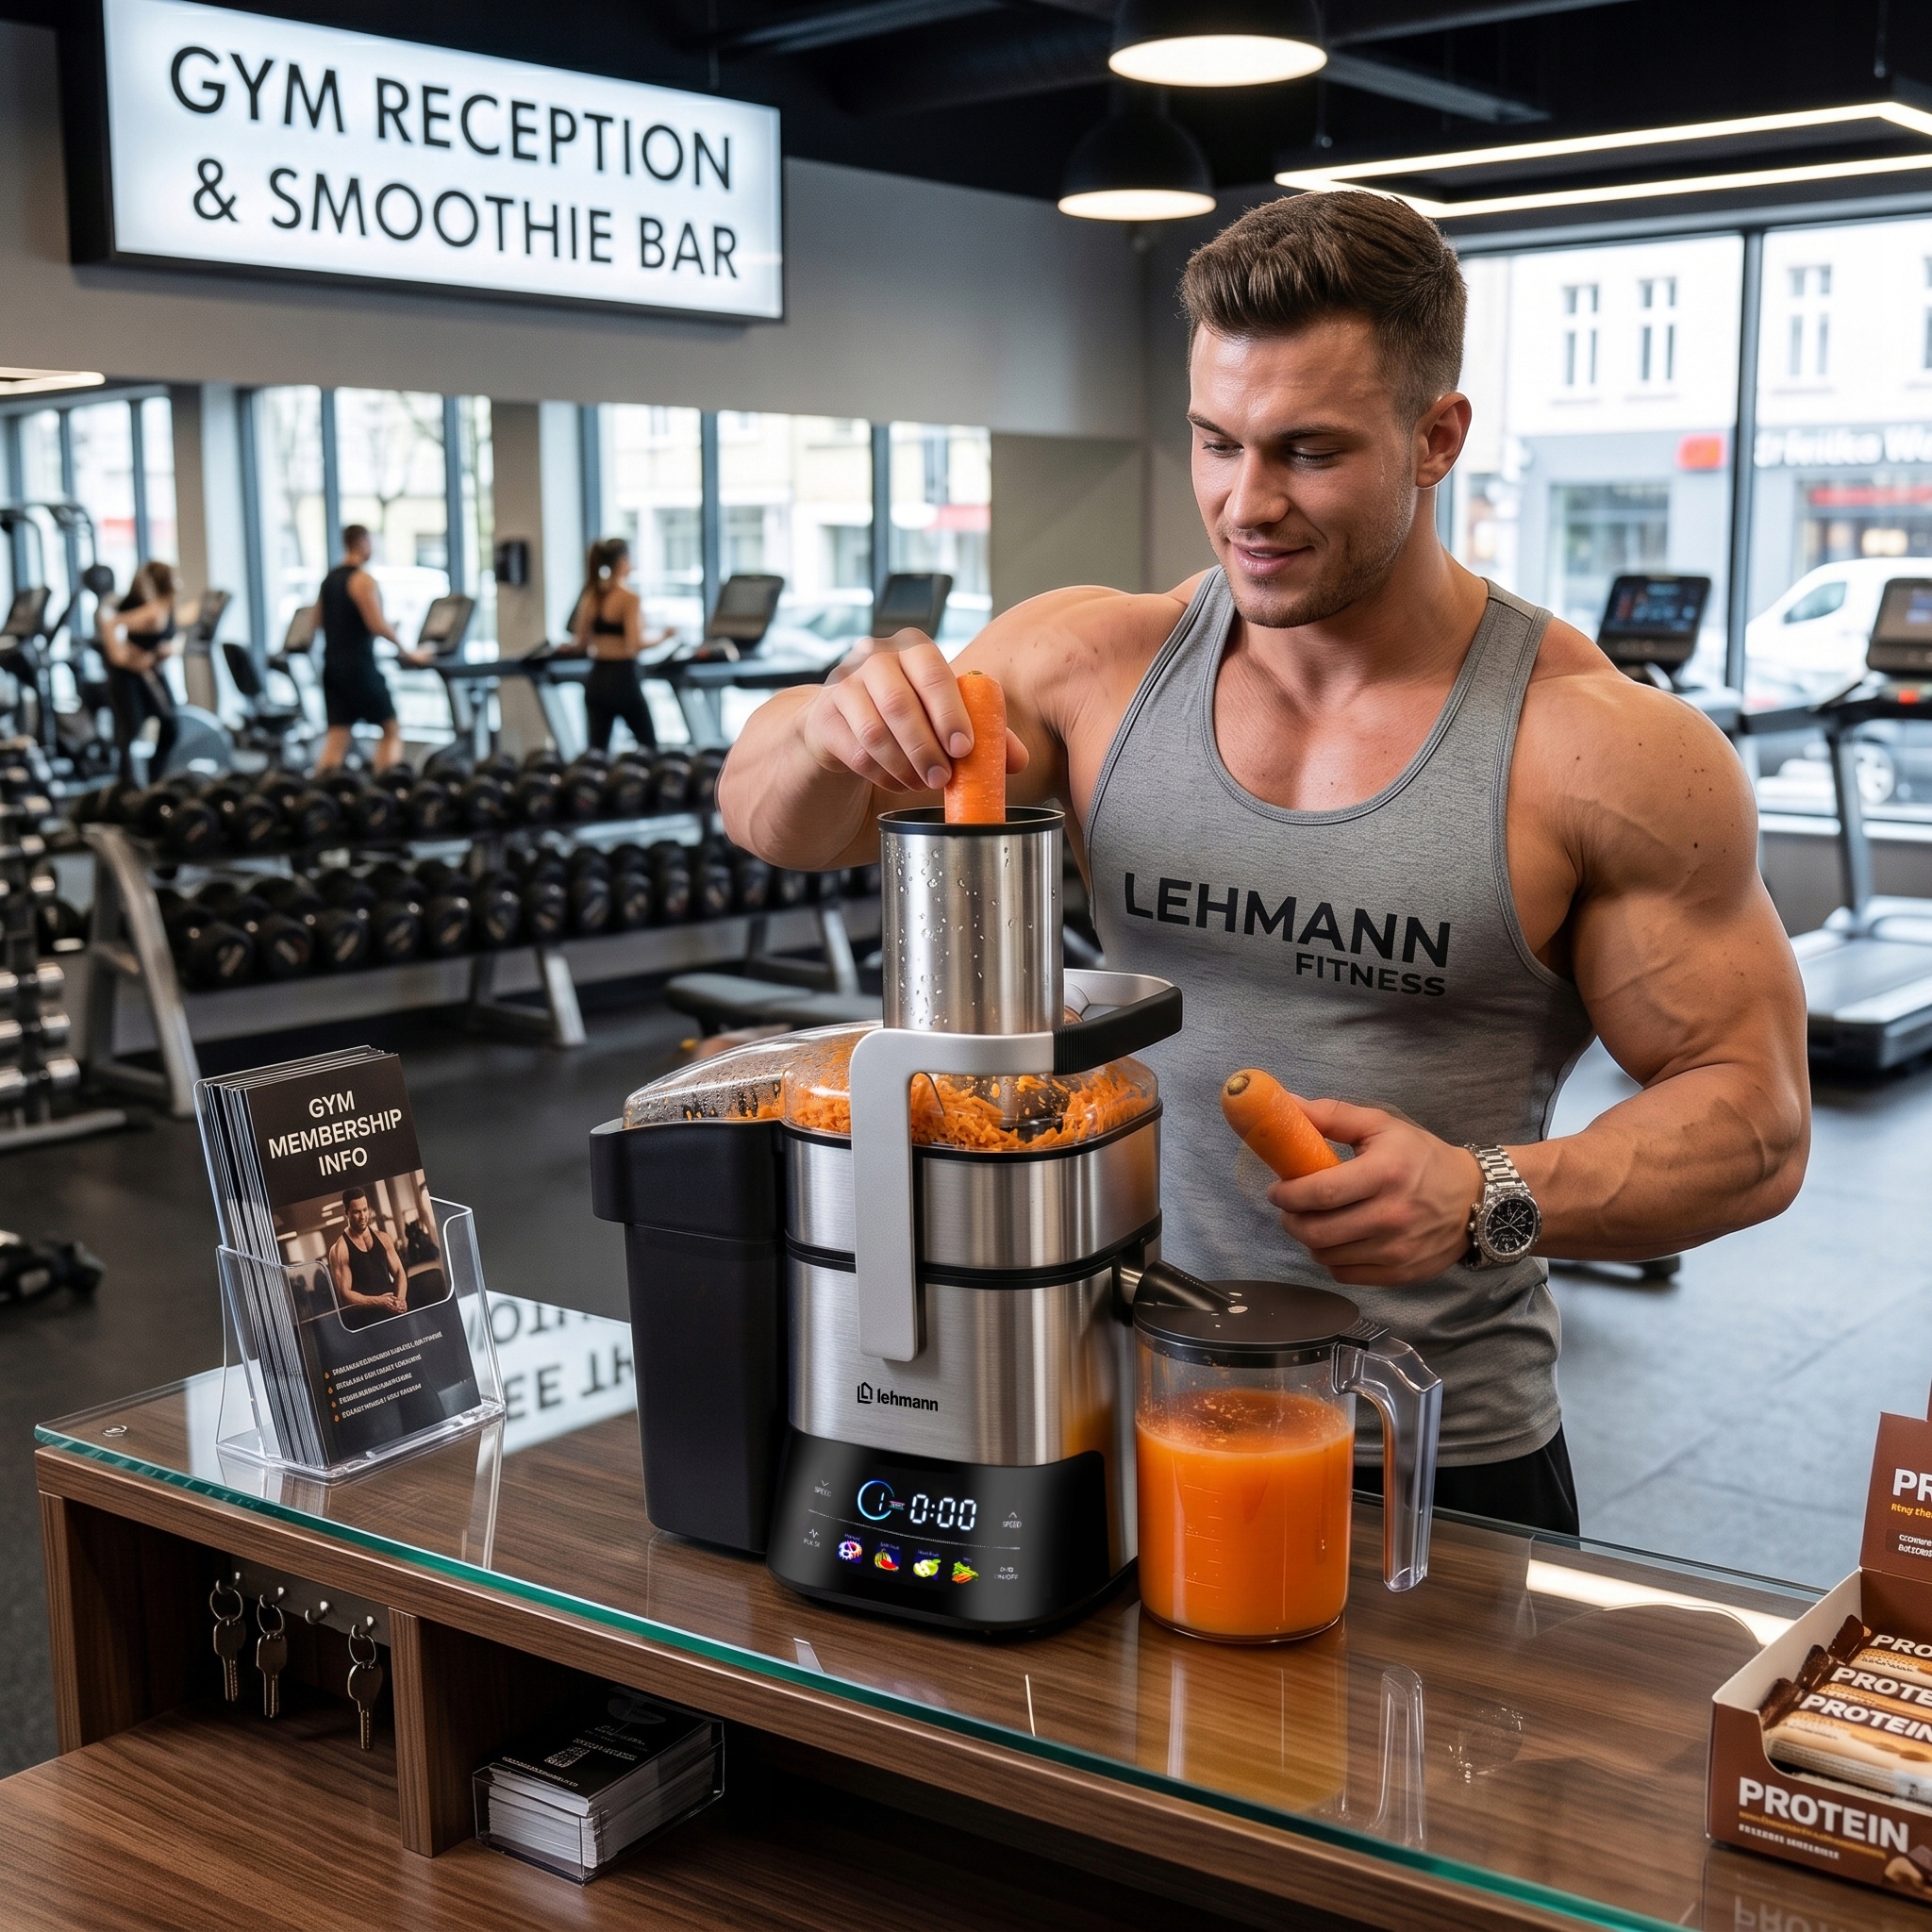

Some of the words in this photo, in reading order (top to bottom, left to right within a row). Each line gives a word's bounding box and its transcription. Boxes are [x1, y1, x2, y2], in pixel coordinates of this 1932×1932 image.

[170, 45, 345, 133] GYM
[375, 75, 731, 191] RECEPTION
[192, 158, 239, 224] &
[269, 167, 613, 264] SMOOTHIE
[640, 216, 739, 278] BAR
[1124, 872, 1451, 968] LEHMANN
[1295, 951, 1446, 997] FITNESS
[308, 1090, 356, 1119] GYM
[268, 1108, 403, 1159] MEMBERSHIP
[318, 1147, 368, 1176] INFO
[876, 1388, 939, 1412] lehmann
[909, 1493, 977, 1531] 0:00
[1799, 1693, 1932, 1744] PROTEIN
[1739, 1776, 1909, 1854] PROTEIN
